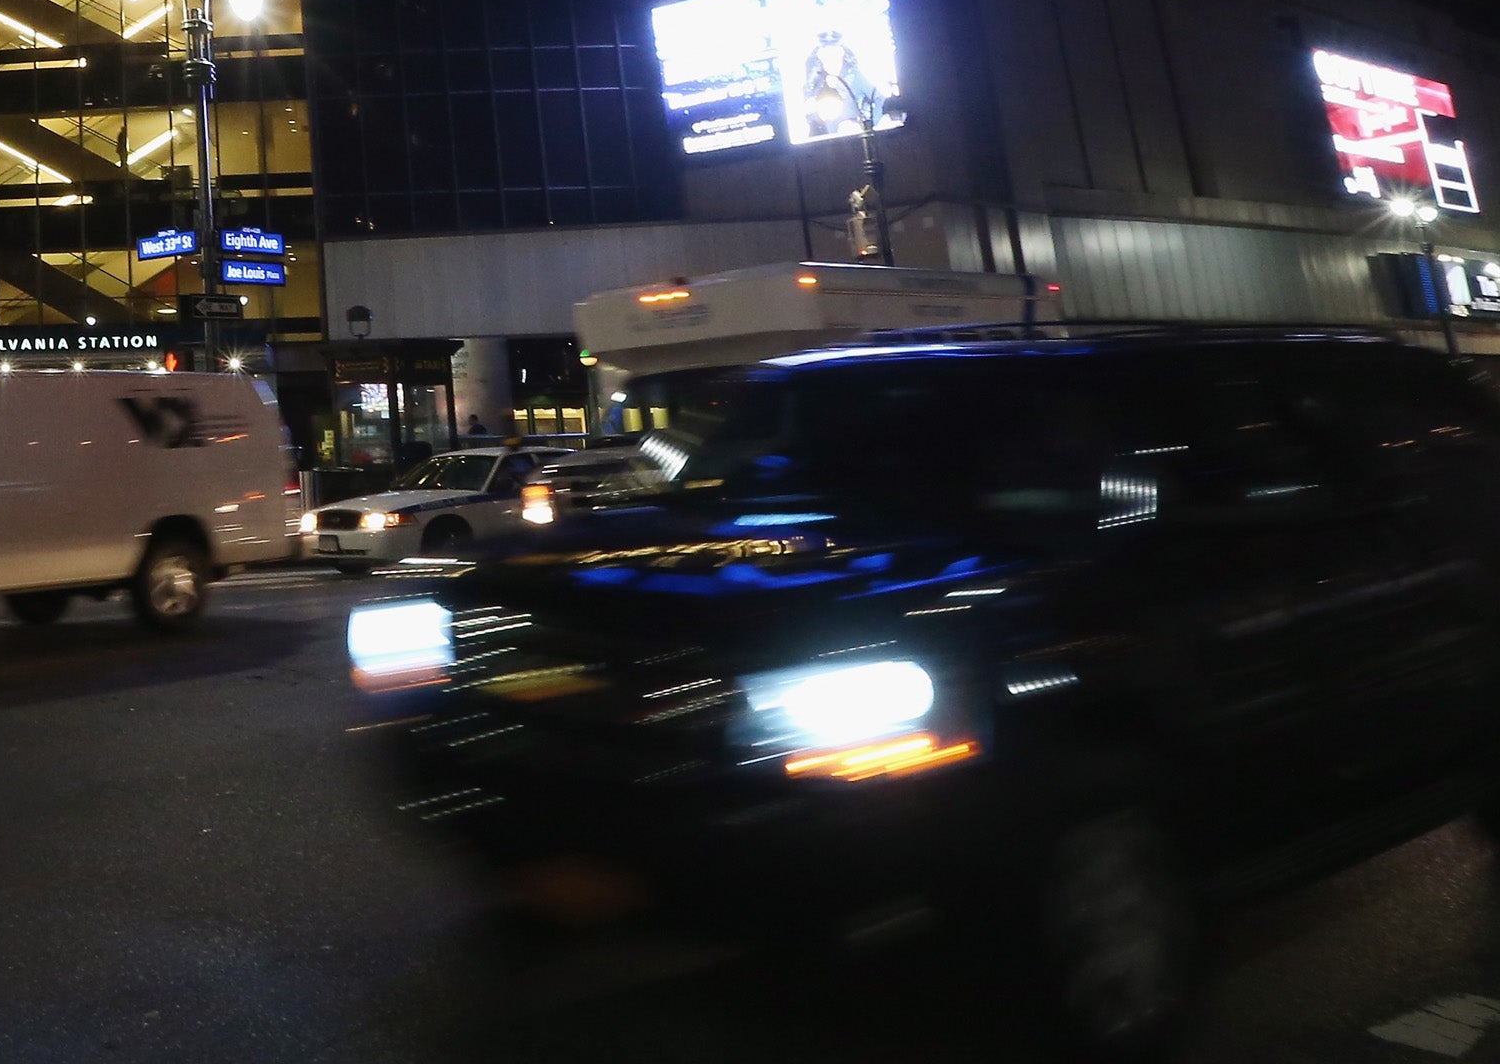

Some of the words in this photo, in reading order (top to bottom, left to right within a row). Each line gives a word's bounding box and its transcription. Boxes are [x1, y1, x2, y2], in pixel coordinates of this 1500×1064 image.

[142, 240, 164, 255] West
[165, 235, 181, 251] 33rd
[182, 235, 193, 249] St
[225, 233, 257, 250] Eighth
[258, 236, 279, 249] Ave
[227, 265, 243, 278] Joe
[243, 266, 265, 279] Louis
[78, 335, 158, 350] STATION
